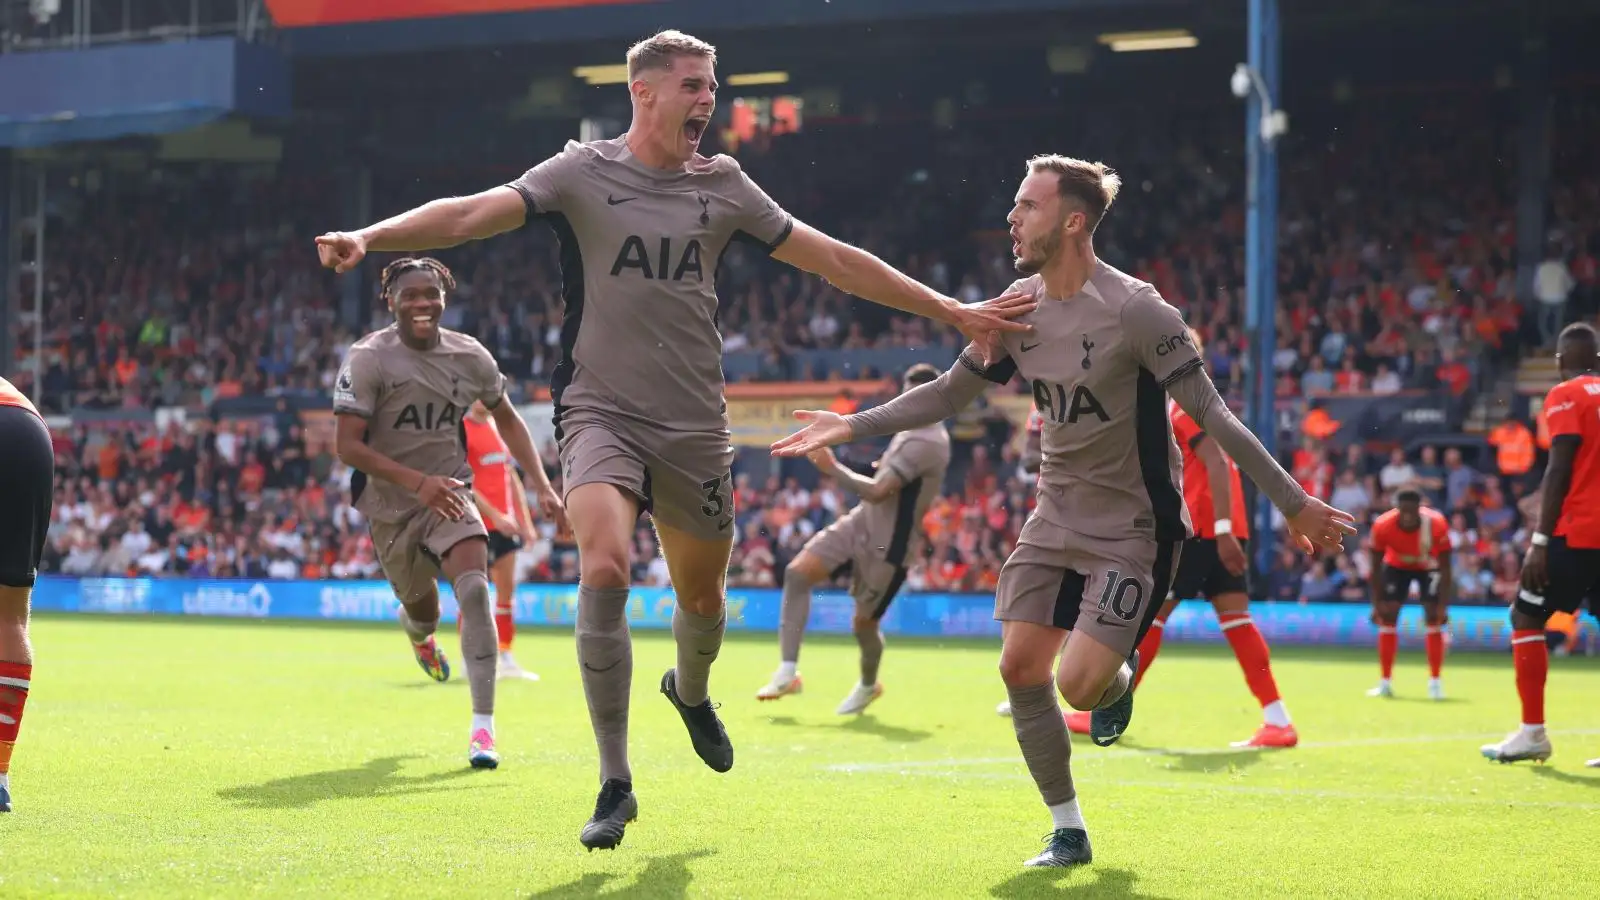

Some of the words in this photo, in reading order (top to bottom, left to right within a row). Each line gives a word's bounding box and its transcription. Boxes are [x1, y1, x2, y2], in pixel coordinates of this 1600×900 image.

[610, 235, 703, 281] AIA
[1156, 329, 1190, 356] cinc
[393, 402, 457, 430] AIA
[1033, 379, 1111, 423] AIA
[1097, 570, 1143, 621] 10
